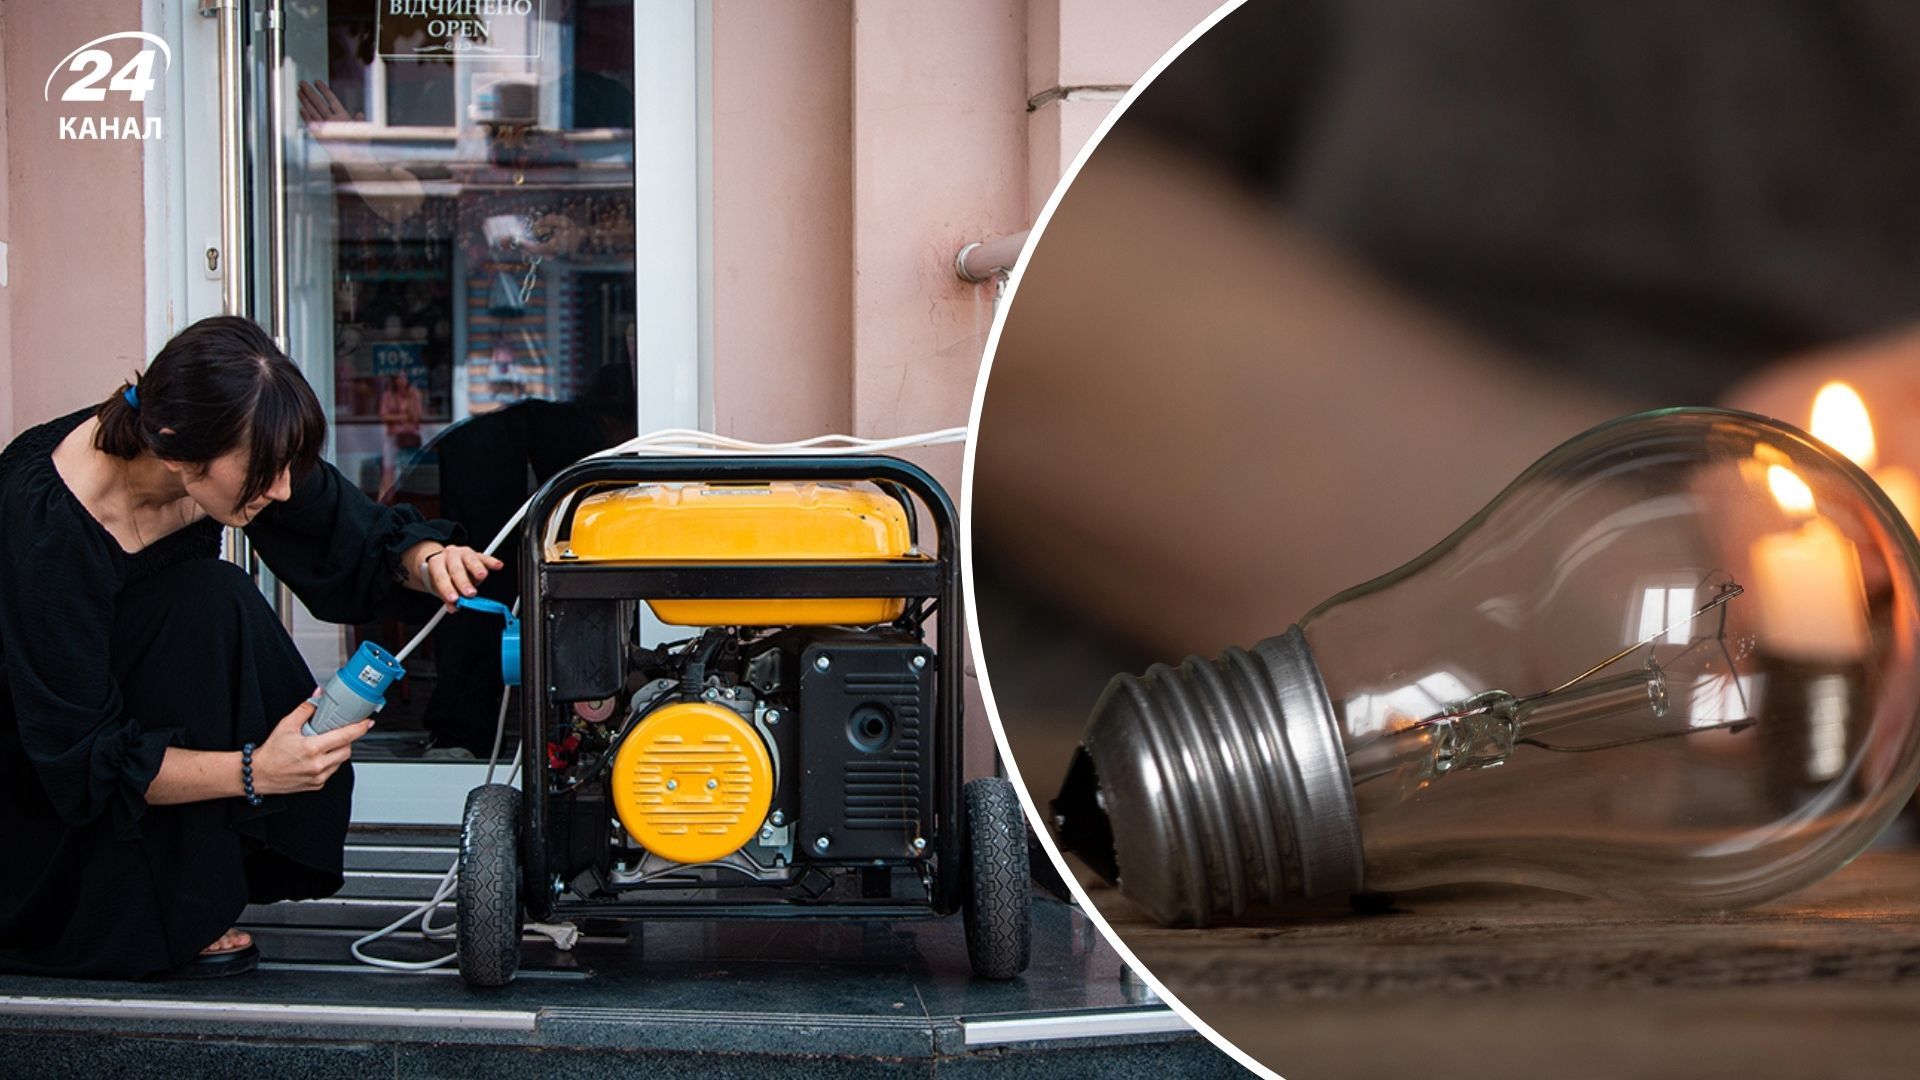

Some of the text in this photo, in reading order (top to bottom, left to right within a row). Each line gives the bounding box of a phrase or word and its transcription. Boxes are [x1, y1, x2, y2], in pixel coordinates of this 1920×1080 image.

[389, 0, 532, 18] ВІДЧИНЕНО
[427, 20, 491, 38] OPEN
[377, 350, 415, 367] 10%
